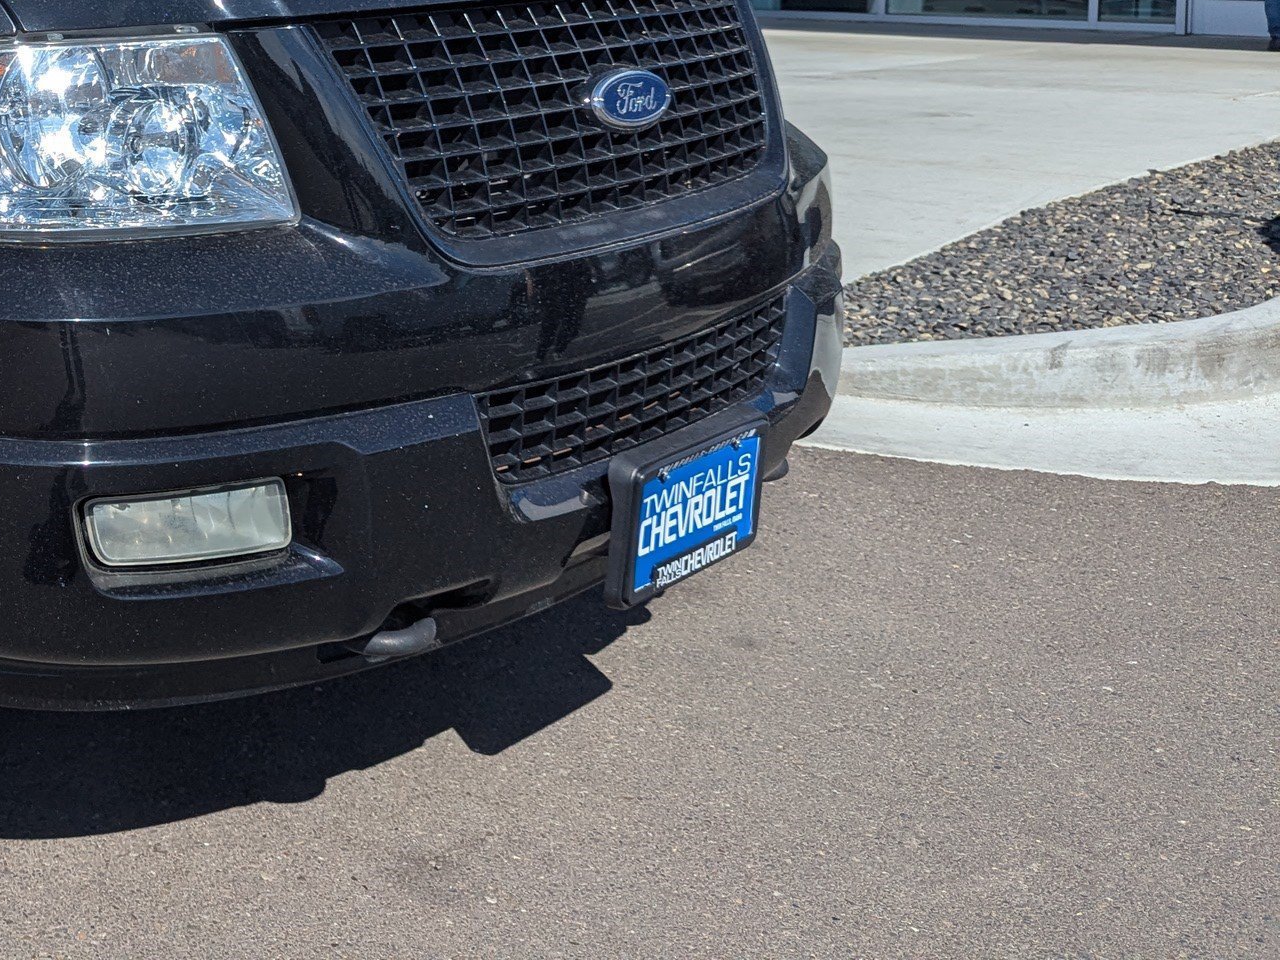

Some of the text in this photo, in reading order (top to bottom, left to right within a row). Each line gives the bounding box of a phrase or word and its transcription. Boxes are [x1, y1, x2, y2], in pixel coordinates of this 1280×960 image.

[616, 81, 657, 115] Ford
[637, 473, 750, 557] CHEVROLET
[657, 557, 682, 581] TWIN
[681, 531, 738, 576] CHEVROLET
[656, 568, 682, 588] FALLS
